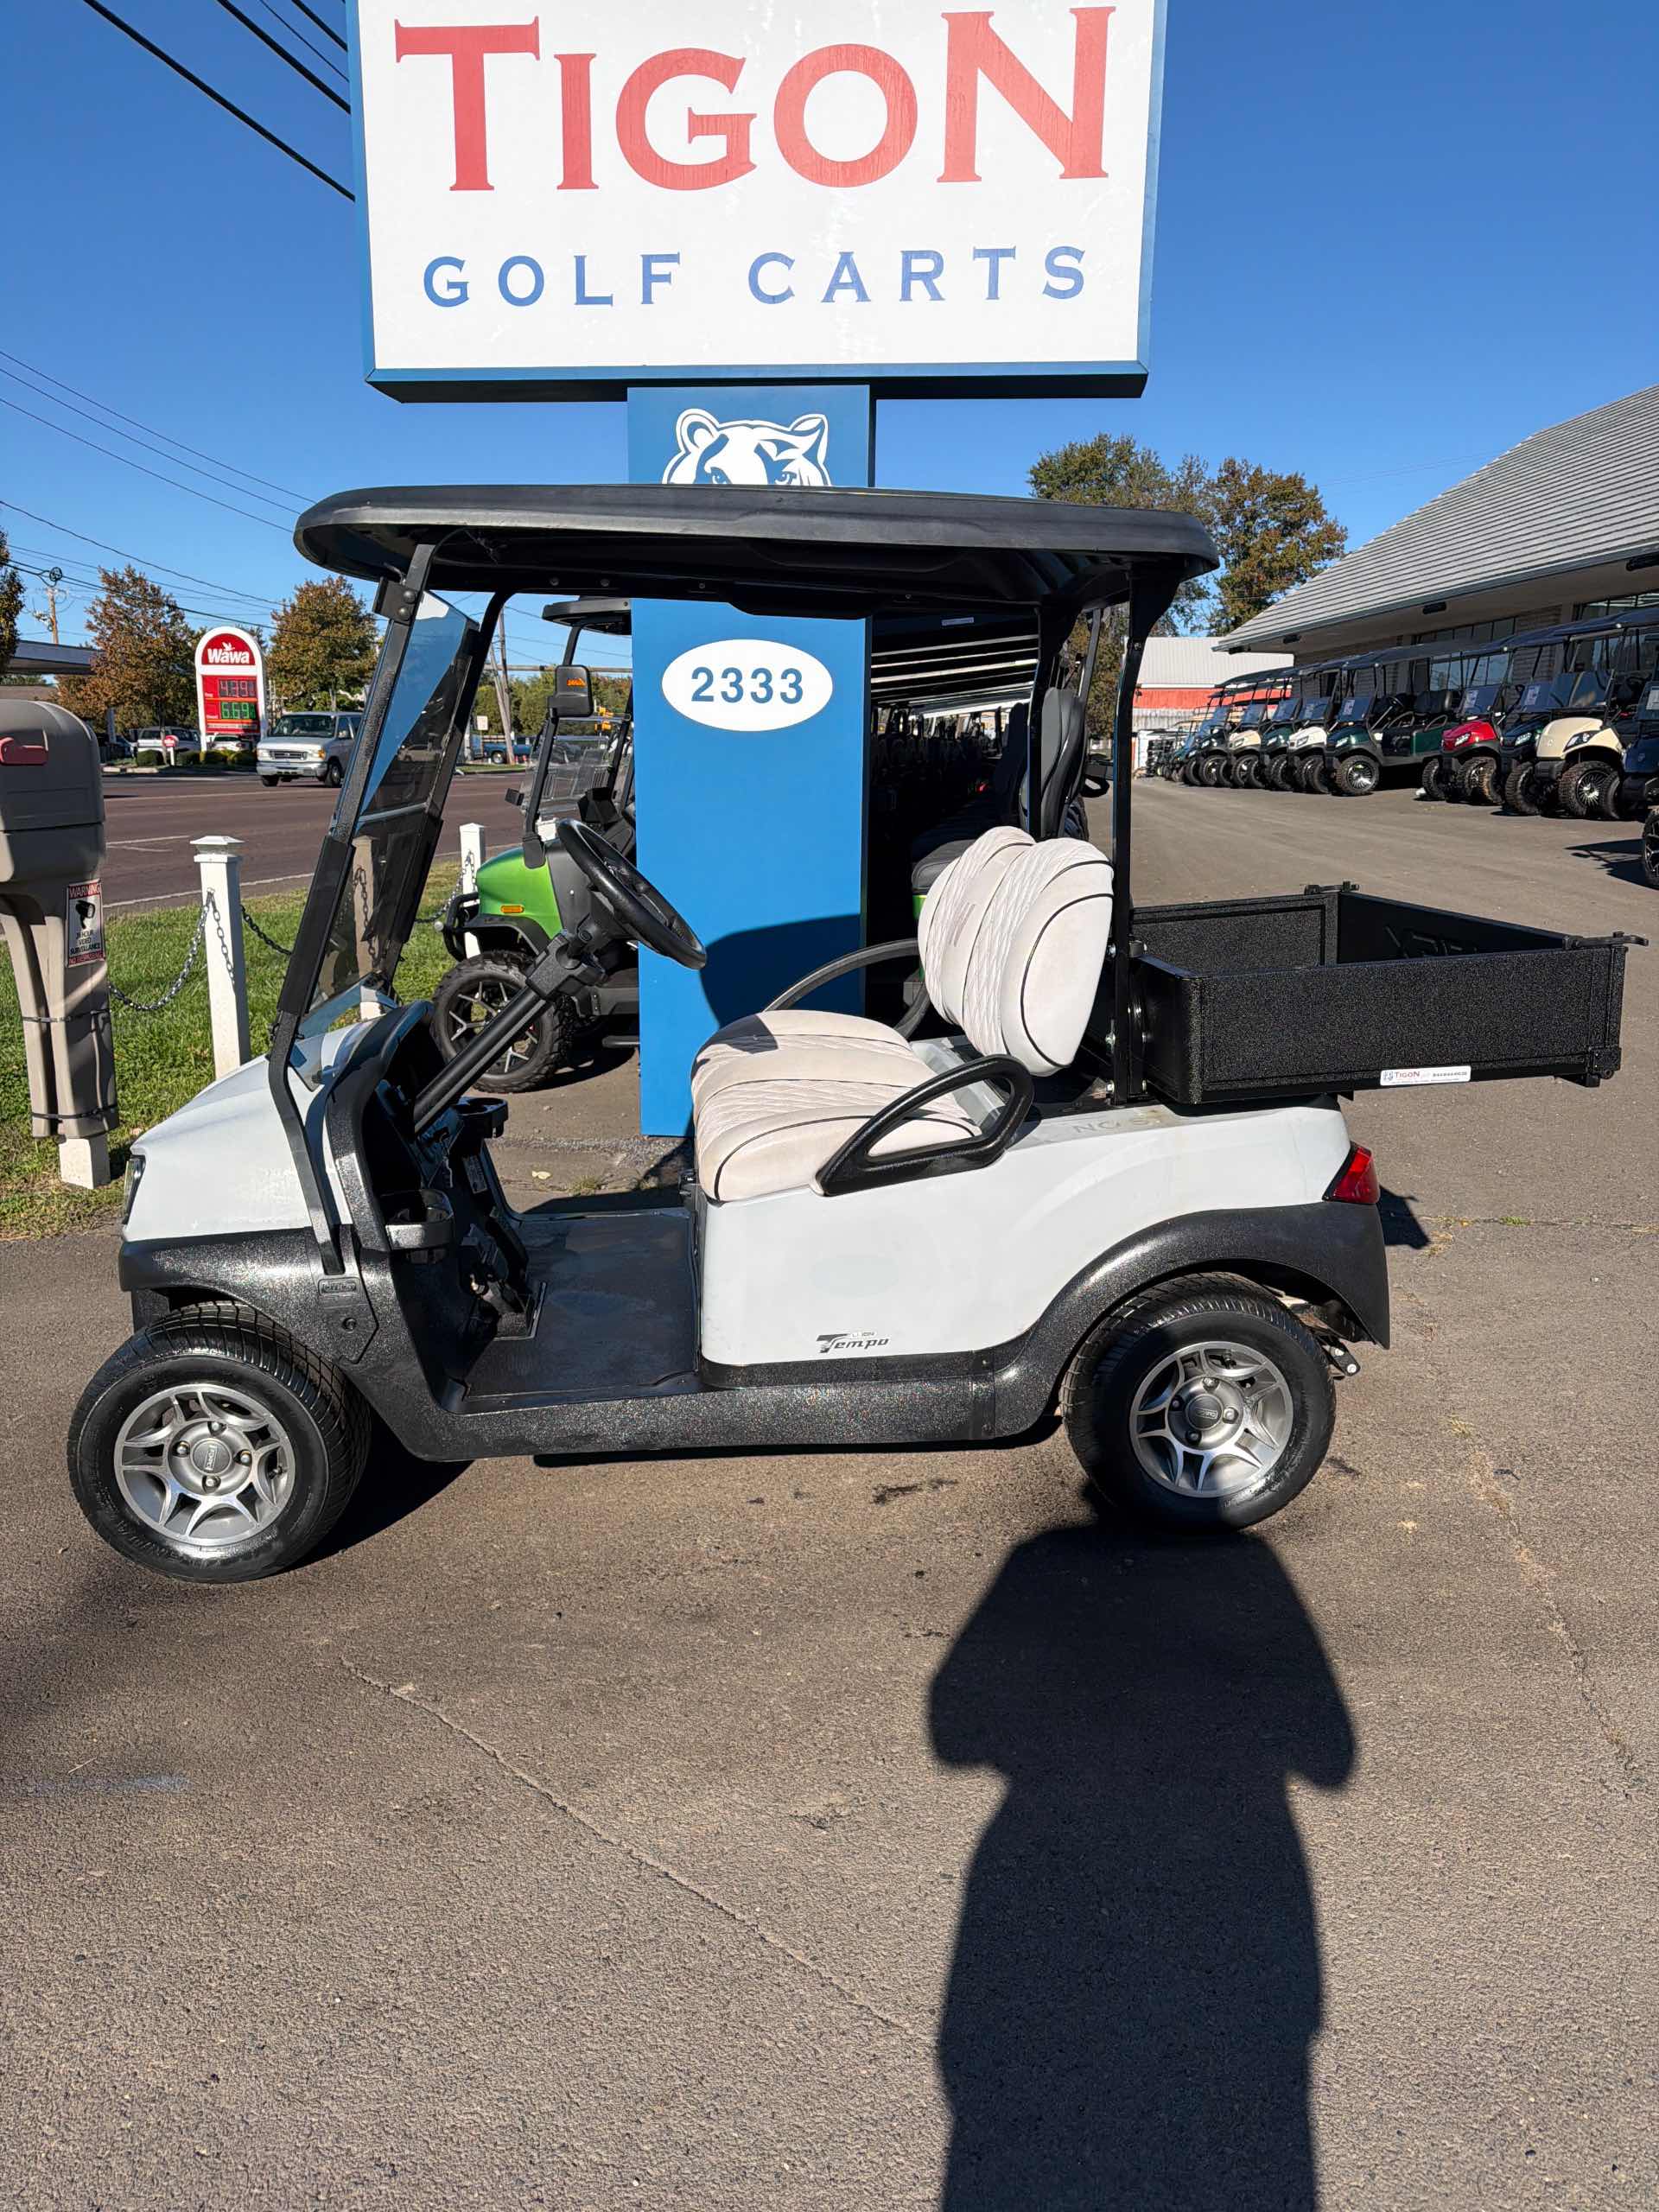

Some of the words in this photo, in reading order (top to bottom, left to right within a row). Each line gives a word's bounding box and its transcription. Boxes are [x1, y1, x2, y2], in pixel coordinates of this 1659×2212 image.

[395, 7, 1116, 191] TIGON
[423, 252, 680, 308] GOLF
[748, 246, 1084, 304] CARTS
[207, 648, 250, 664] Wawa
[691, 666, 804, 704] 2333
[69, 883, 100, 898] WARNING
[816, 1332, 889, 1353] Tempo
